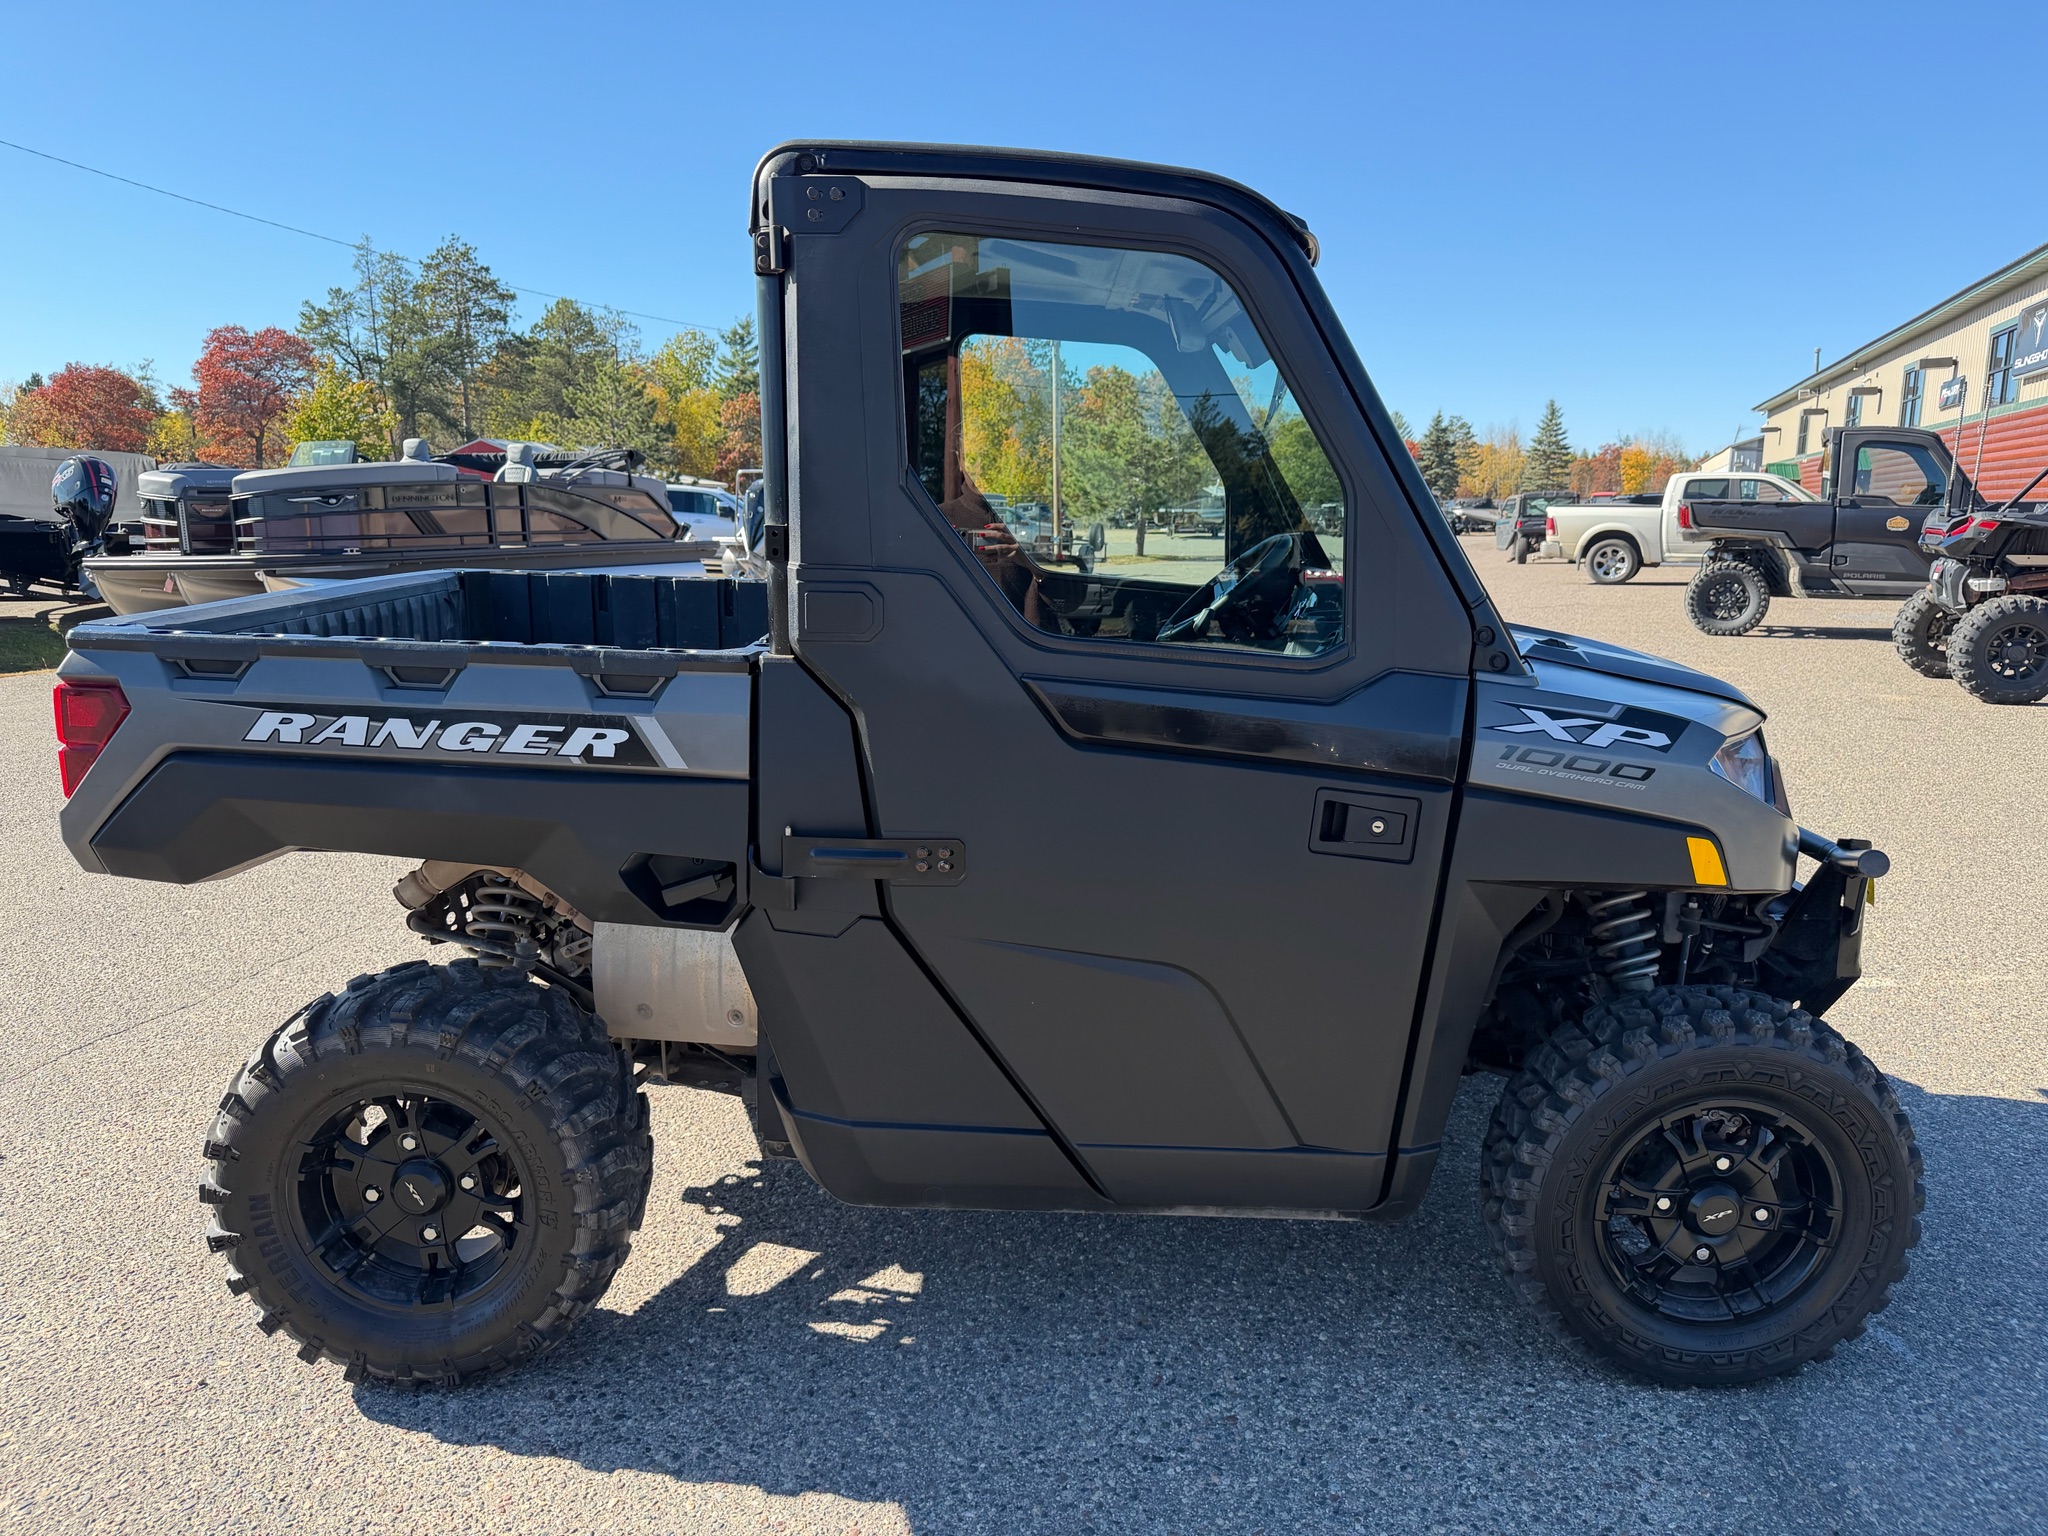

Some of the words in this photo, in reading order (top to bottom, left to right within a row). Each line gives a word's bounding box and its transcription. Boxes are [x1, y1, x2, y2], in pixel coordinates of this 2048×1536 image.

[391, 494, 454, 503] BENNINGTON
[1843, 572, 1886, 580] POLARIS
[243, 711, 630, 758] RANGER
[1493, 707, 1672, 748] XP
[1495, 762, 1534, 773] DUAL
[1538, 769, 1613, 785] OVERHEAD
[1615, 781, 1647, 791] CAM
[1499, 745, 1656, 781] 1000
[404, 1181, 424, 1206] XP
[1702, 1209, 1733, 1222] XP
[248, 1193, 341, 1325] X-TERRAIN
[1753, 1306, 1807, 1340] POWER
